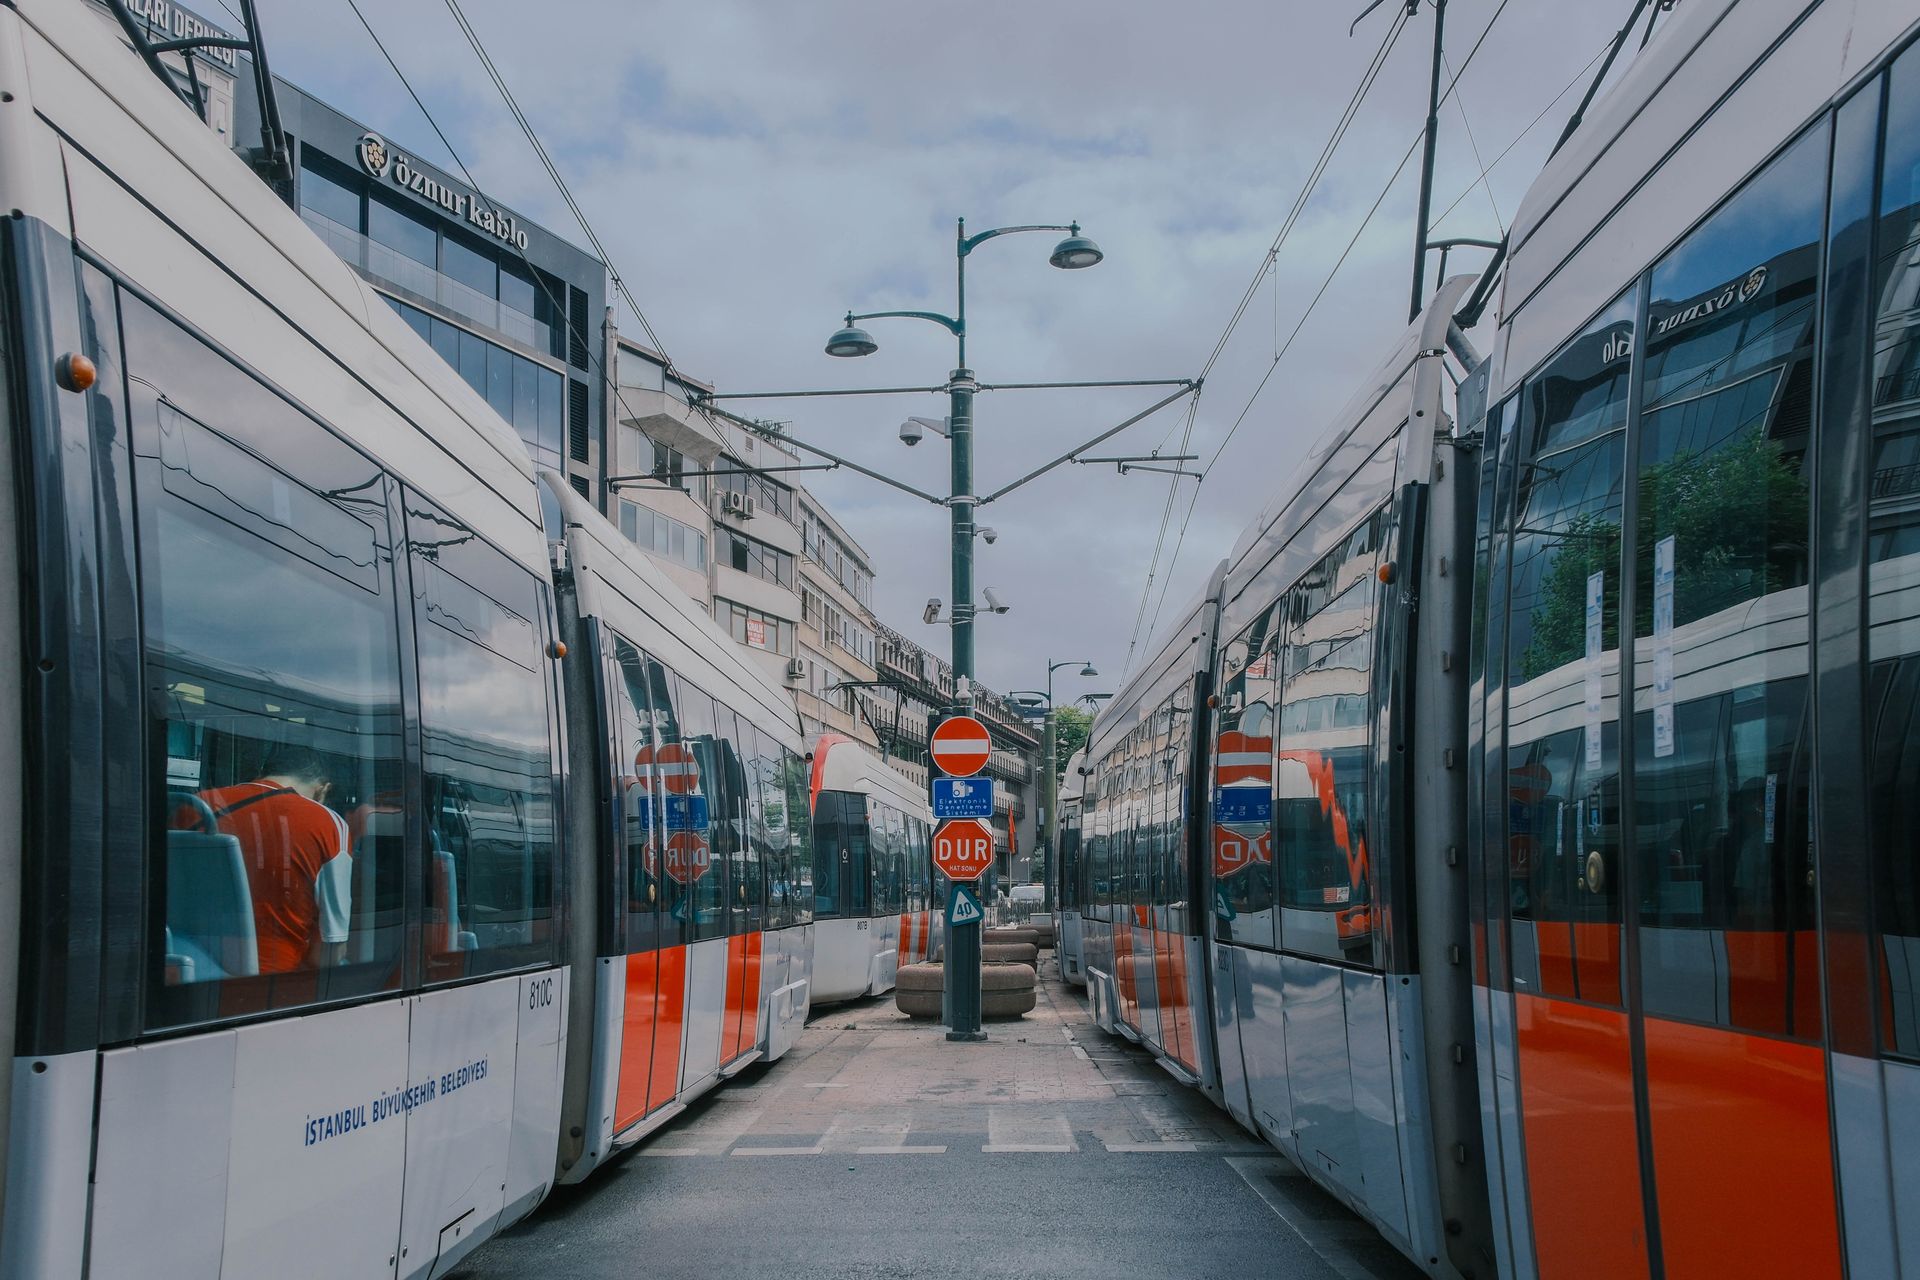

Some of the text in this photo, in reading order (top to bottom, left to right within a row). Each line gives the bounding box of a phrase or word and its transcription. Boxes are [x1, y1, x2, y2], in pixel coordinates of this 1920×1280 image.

[396, 155, 529, 250] öznur kablo
[939, 838, 988, 861] DUR
[957, 902, 972, 915] 40
[529, 977, 552, 1010] 810C
[304, 1053, 488, 1147] İSTANBUL BÜYÜKŞEHİR BELEDİYESİ
